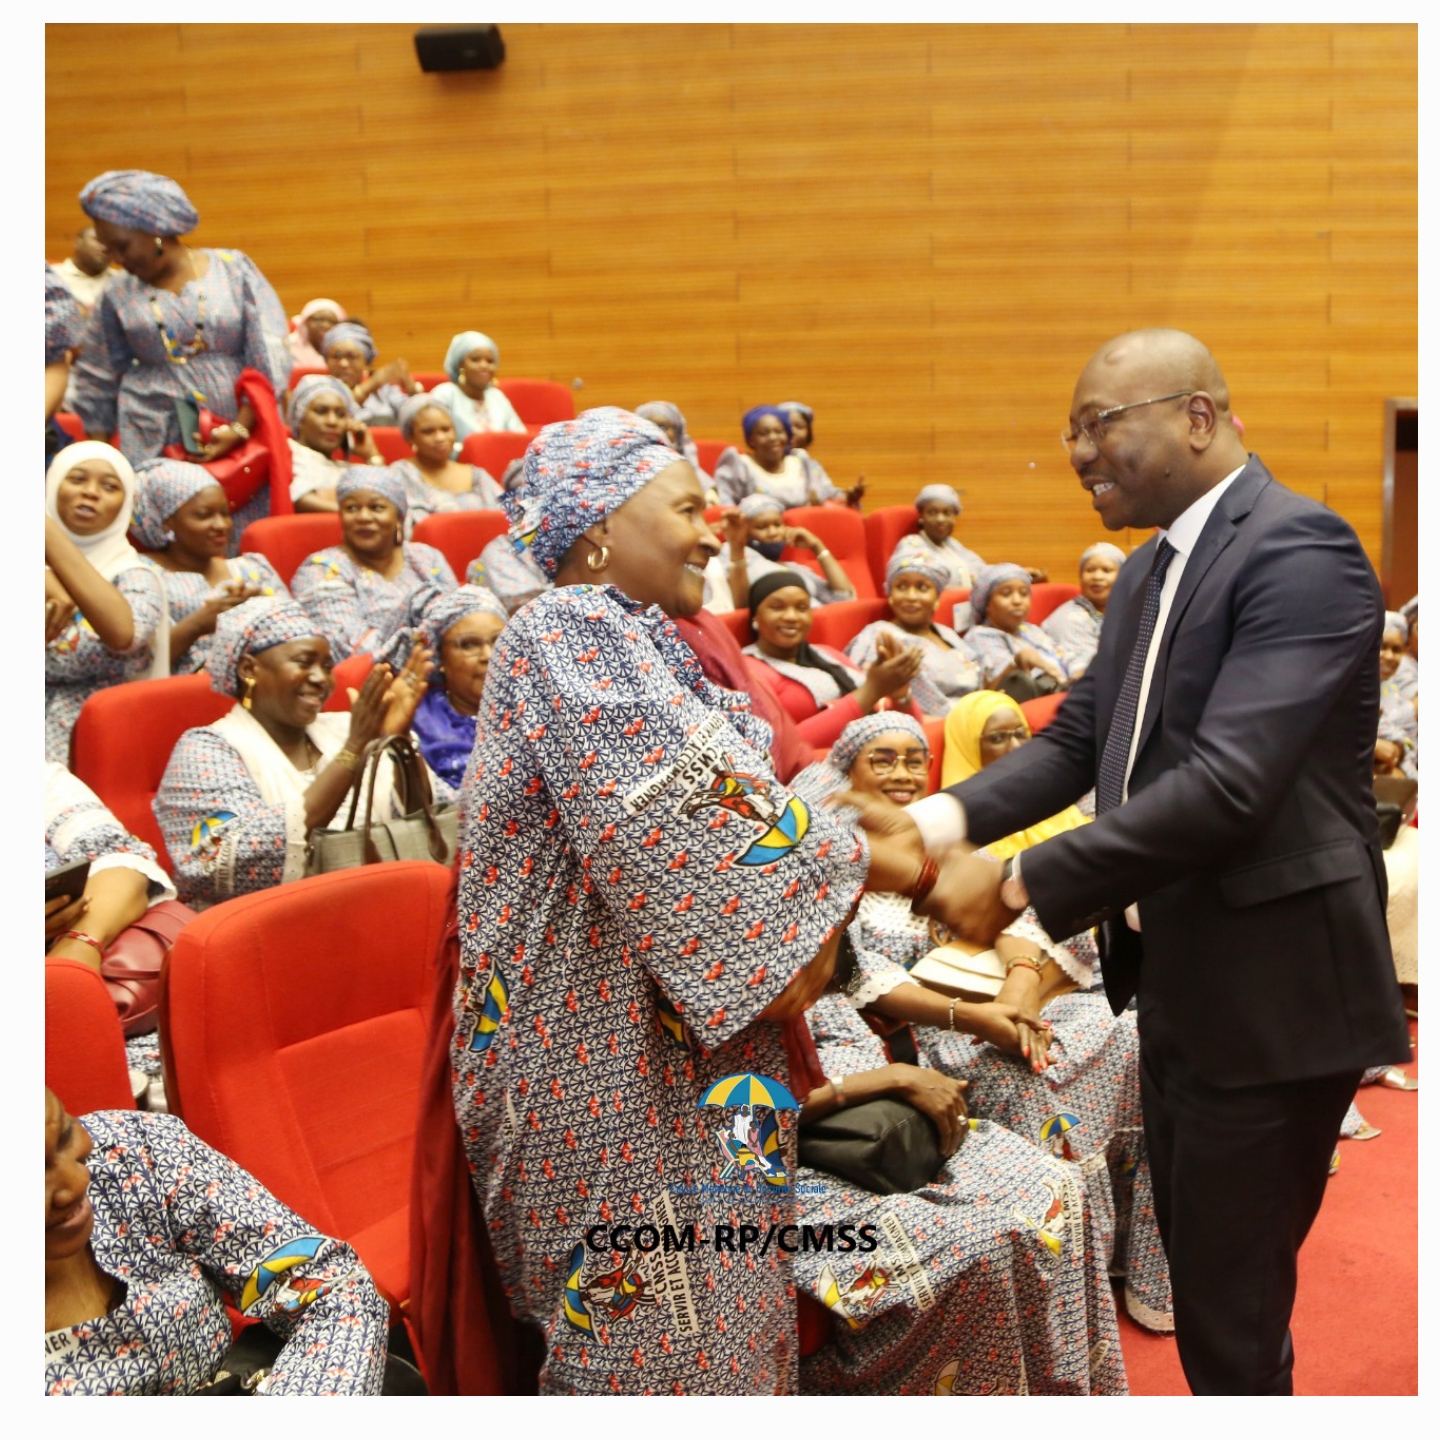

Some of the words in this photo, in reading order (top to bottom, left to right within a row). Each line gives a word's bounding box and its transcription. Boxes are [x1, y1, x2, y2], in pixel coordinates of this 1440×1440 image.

[682, 747, 718, 785] CMSS
[649, 1251, 668, 1295] CMSS
[669, 1278, 685, 1292] ET
[672, 1293, 693, 1333] SERVIR
